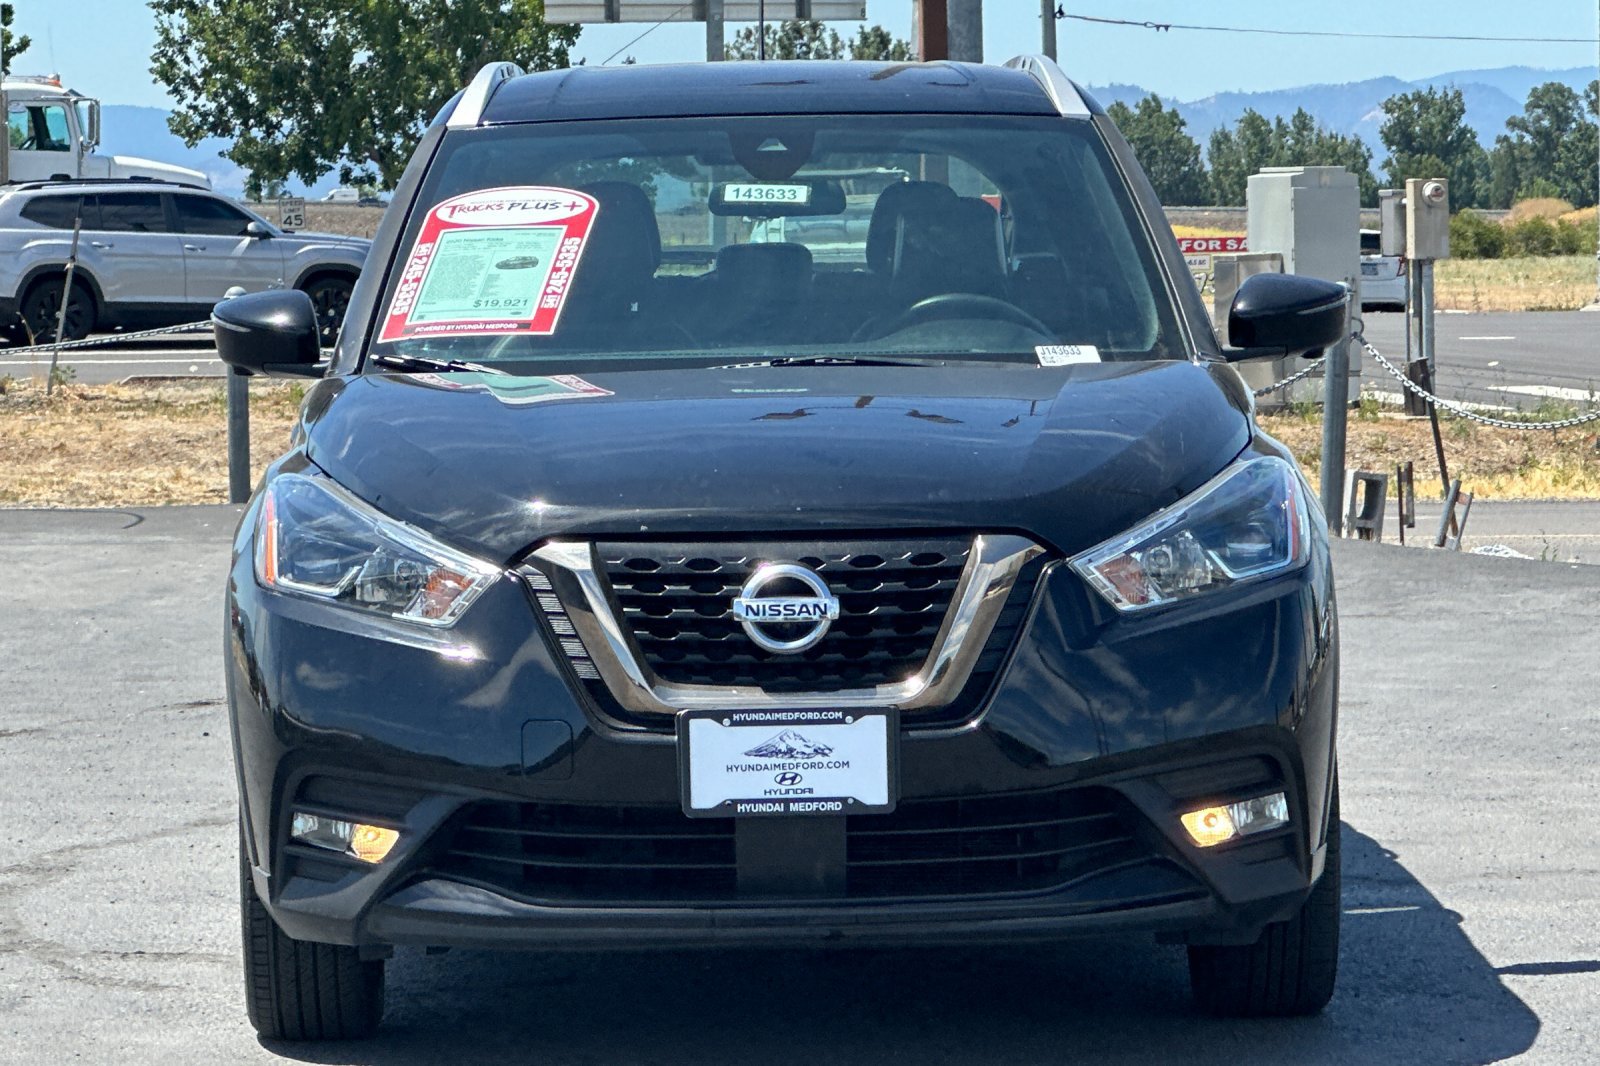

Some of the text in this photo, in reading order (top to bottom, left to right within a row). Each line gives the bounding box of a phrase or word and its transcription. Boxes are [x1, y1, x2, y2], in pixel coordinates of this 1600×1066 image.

[732, 187, 797, 200] 143633
[445, 202, 505, 218] TRUCKS
[507, 201, 562, 211] PLUS
[283, 214, 303, 226] 45
[1180, 239, 1221, 251] FOR
[546, 237, 581, 295] 245-5335
[415, 324, 446, 333] POWERED
[484, 322, 518, 330] MEDFORD
[745, 603, 828, 617] NISSAN
[732, 711, 843, 722] HYUNDAIMEDFORD.COM
[726, 760, 850, 772] HYUNDAIMEDFORD.COM
[763, 787, 814, 796] HYUNDAI
[737, 801, 843, 813] HYUNDAI MEDFORD
